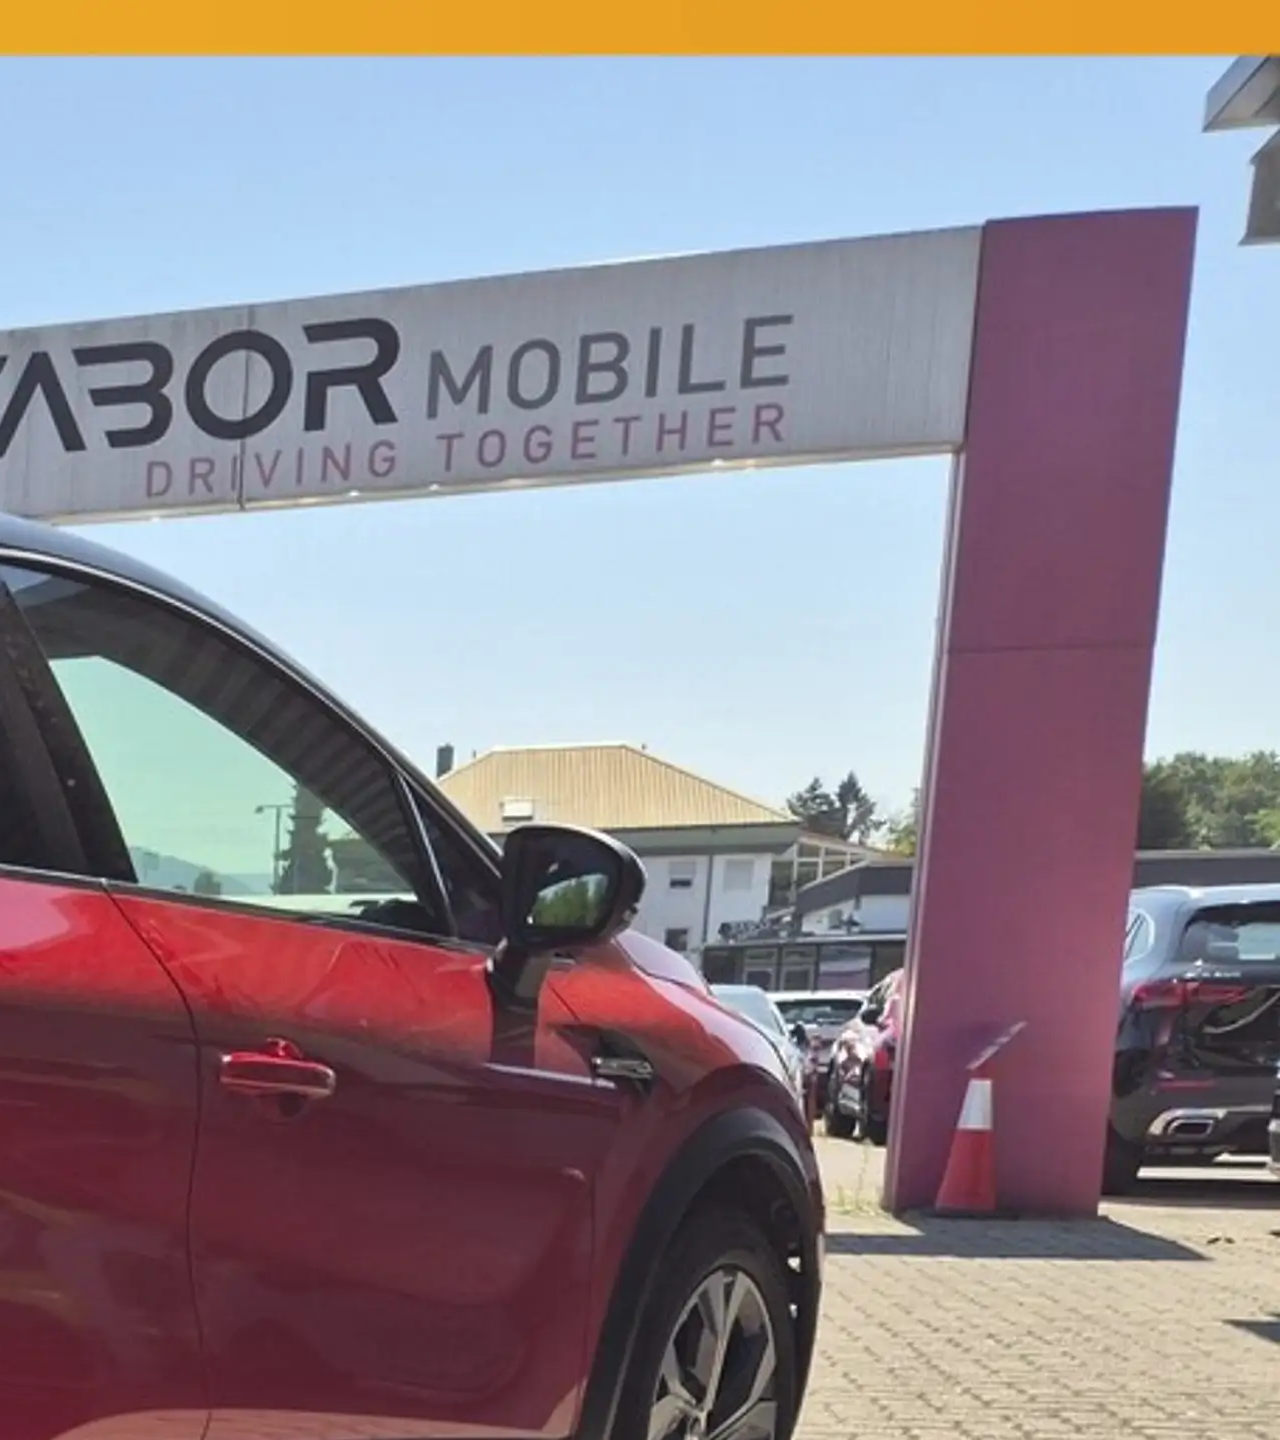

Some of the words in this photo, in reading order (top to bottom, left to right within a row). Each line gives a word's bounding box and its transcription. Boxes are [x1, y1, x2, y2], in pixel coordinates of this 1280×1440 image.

[426, 314, 794, 420] MOBILE
[144, 439, 398, 498] DRIVING
[435, 403, 785, 473] TOGETHER
